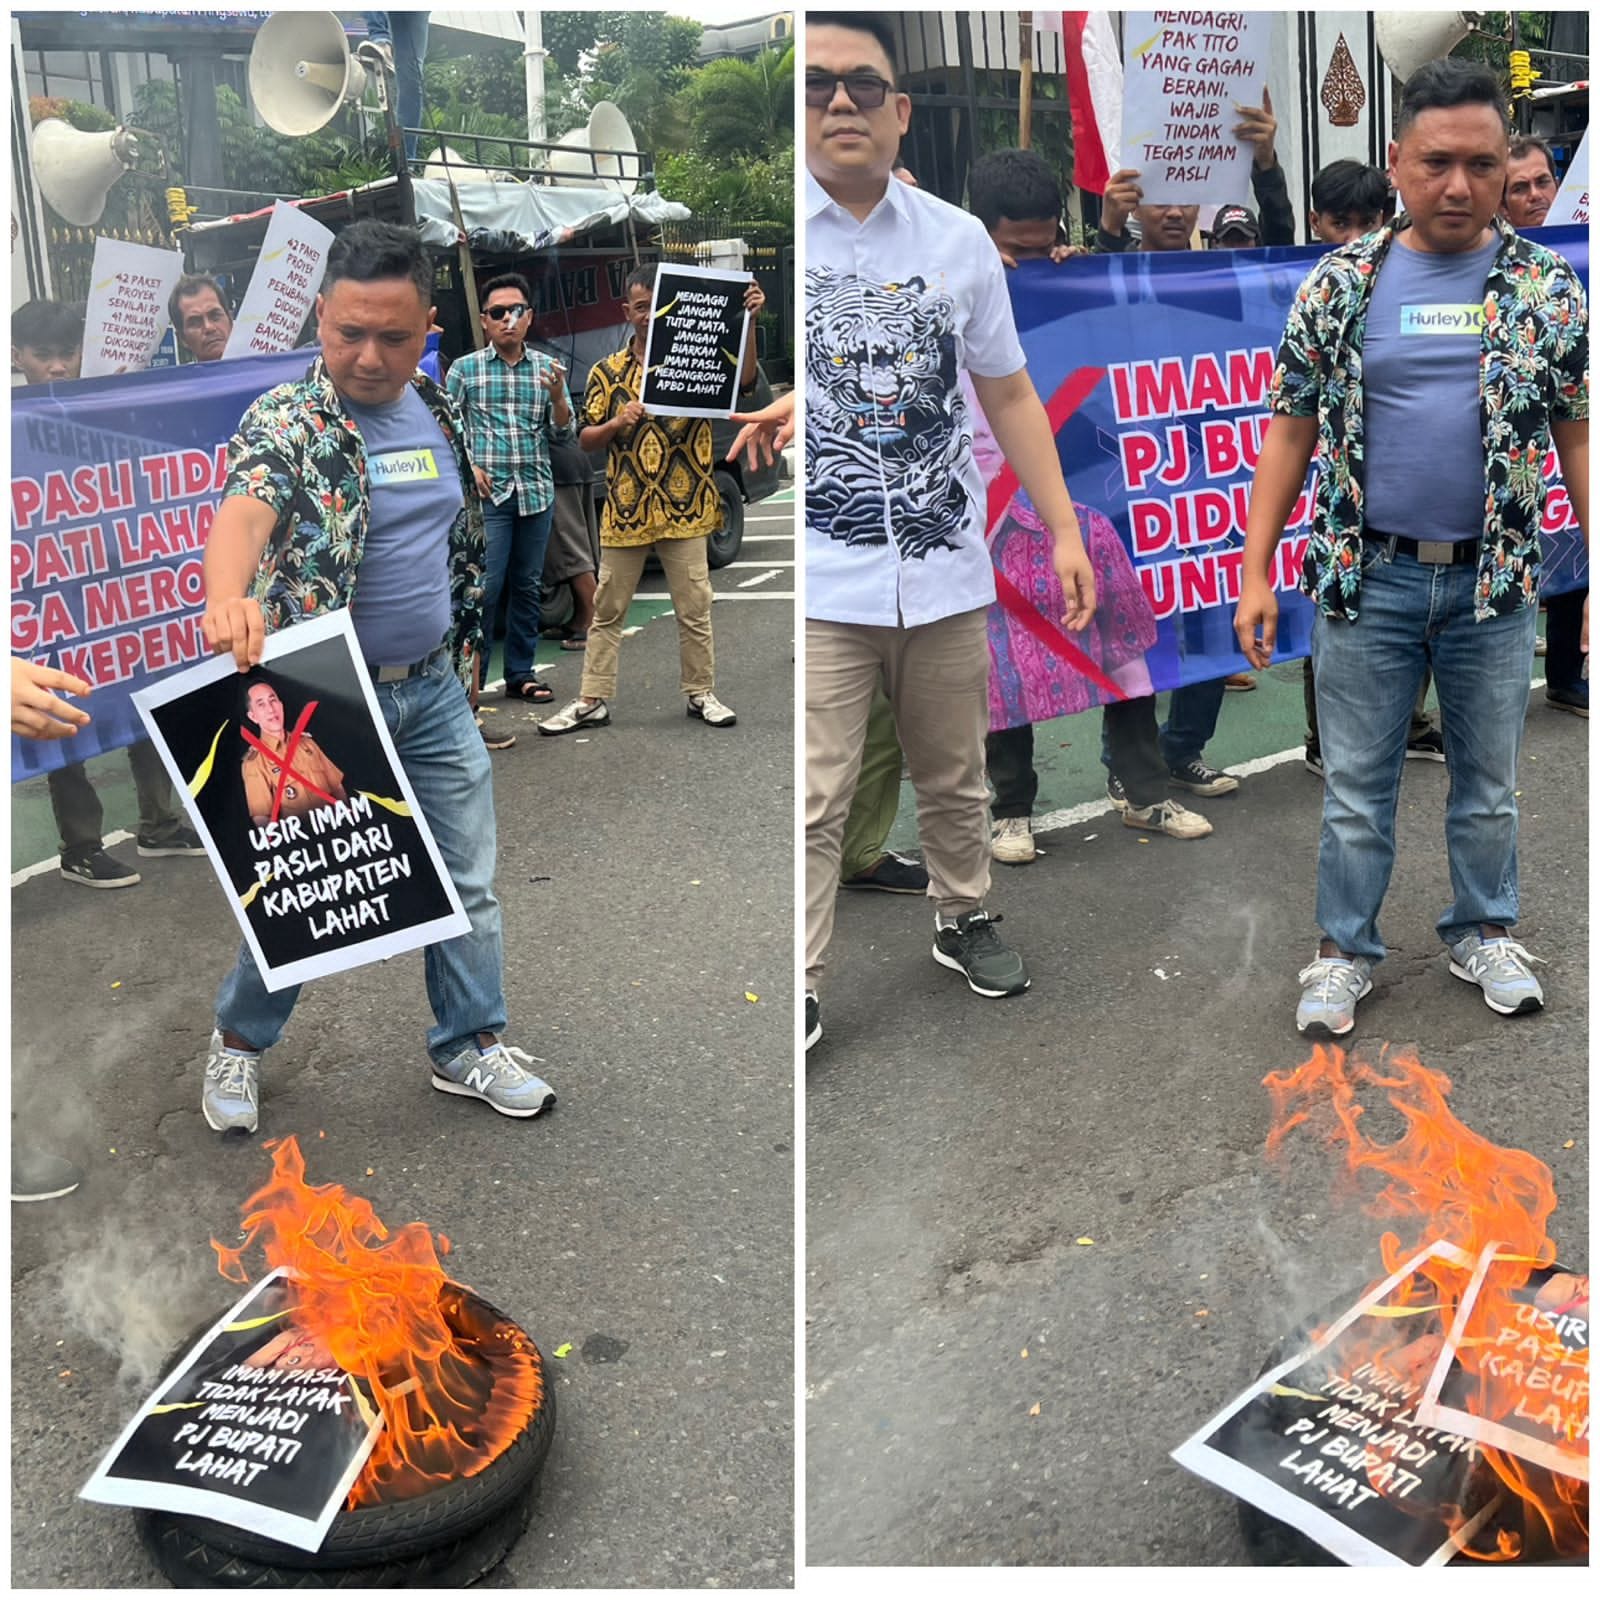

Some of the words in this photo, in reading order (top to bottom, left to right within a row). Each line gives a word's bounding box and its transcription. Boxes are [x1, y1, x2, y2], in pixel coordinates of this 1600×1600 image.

[1162, 30, 1197, 50] PAK
[1203, 33, 1239, 53] TITO
[1142, 53, 1192, 74] YANG
[1195, 58, 1255, 78] GAGAH
[1170, 102, 1220, 119] WAJIB
[1164, 123, 1223, 141] TINDAK
[1143, 144, 1195, 162] TEGAS
[1198, 145, 1237, 161] IMAM
[1165, 166, 1211, 182] PASLI
[287, 238, 299, 250] 42
[299, 243, 321, 262] PAKET
[287, 253, 315, 277] PROYEK
[115, 273, 129, 283] 42
[131, 275, 163, 289] PAKET
[287, 270, 308, 288] APBD
[108, 297, 147, 313] SENILAI
[118, 286, 157, 301] PROYEK
[676, 290, 729, 308] MENDAGRI
[665, 316, 697, 329] TUTUP
[677, 305, 722, 319] JANGAN
[1409, 311, 1462, 326] Hurley
[673, 330, 719, 345] JANGAN
[101, 348, 126, 361] IMAM
[128, 353, 146, 363] PAS
[671, 343, 718, 357] BIARKAN
[664, 354, 690, 368] IMAM
[691, 358, 722, 371] PASLI
[654, 366, 728, 384] MERONGRONG
[1108, 347, 1275, 424] IMAM
[656, 379, 685, 392] APBD
[686, 383, 723, 396] LAHAT
[374, 459, 415, 475] Hurley
[1118, 424, 1190, 492] PJ
[11, 465, 135, 530] PASLI
[248, 815, 310, 851] USIR
[309, 793, 373, 835] IMAM
[254, 843, 328, 888] PASLI
[331, 824, 393, 862] DARI
[262, 853, 412, 918] KABUPATEN
[308, 893, 391, 940] LAHAT
[1516, 1304, 1588, 1345] USIR
[221, 1364, 279, 1383] IMAM
[283, 1367, 350, 1386] PASLI
[1352, 1361, 1421, 1400] IMAM
[195, 1381, 265, 1403] TIDAK
[263, 1386, 353, 1415] LAYAK
[1319, 1375, 1400, 1418] TIDAK
[198, 1403, 310, 1434] MENJADI
[1514, 1394, 1589, 1440] LAH
[172, 1422, 212, 1444] PJ
[208, 1427, 303, 1465] BUPATI
[1317, 1403, 1437, 1469] MENJADI
[174, 1450, 269, 1487] LAHAT
[1284, 1417, 1330, 1445] PJ
[1319, 1435, 1422, 1499] BUPATI
[1279, 1449, 1381, 1511] LAHAT
